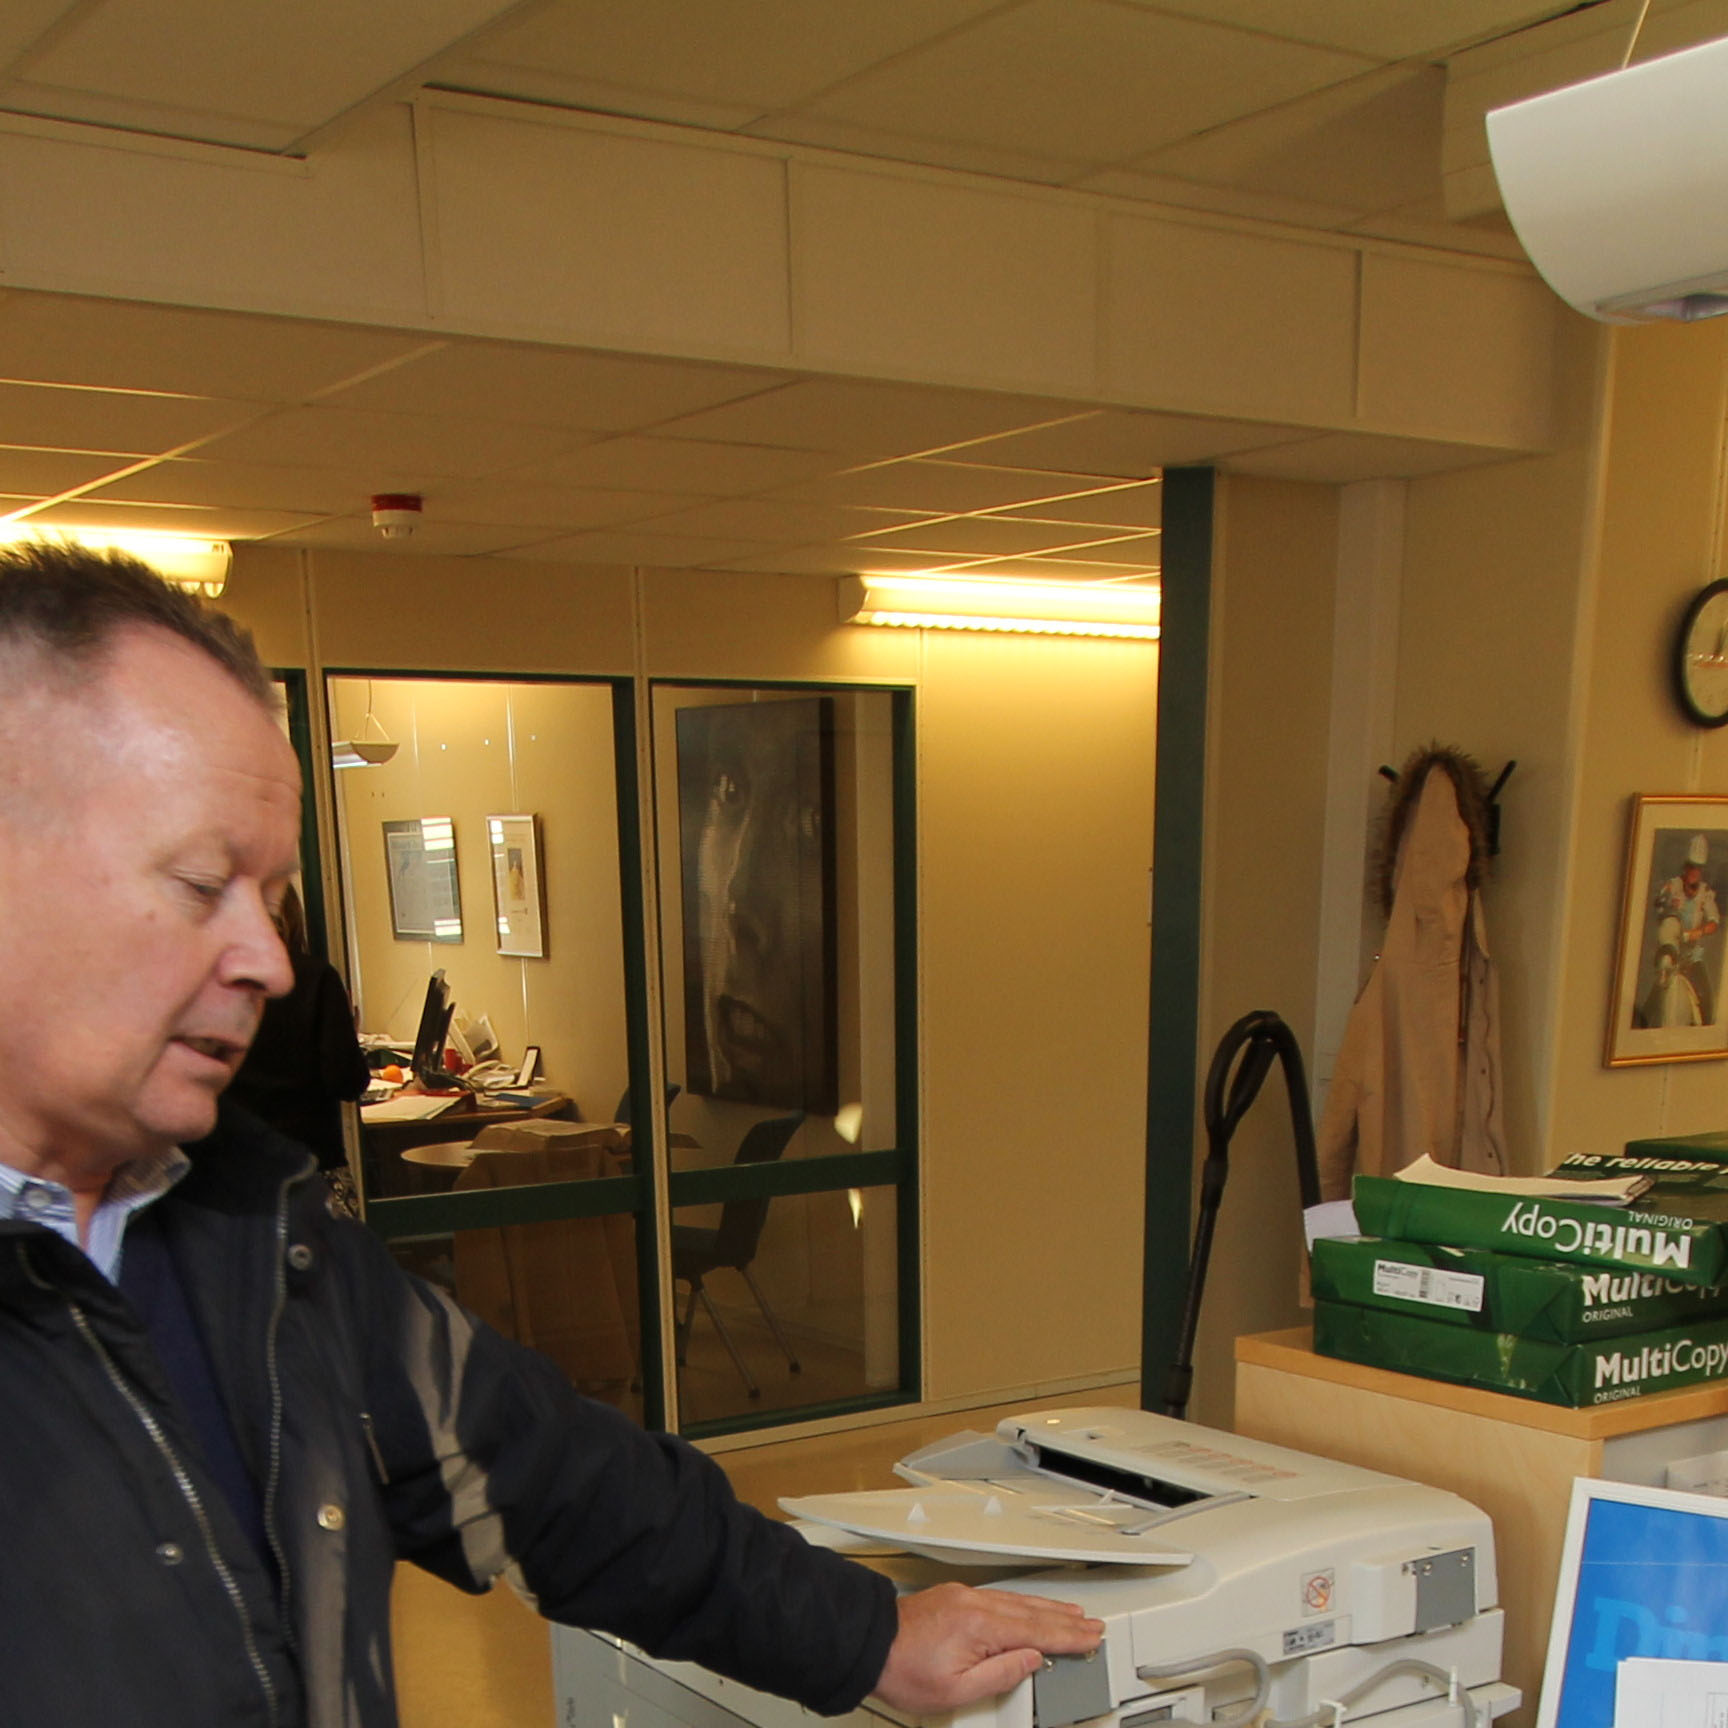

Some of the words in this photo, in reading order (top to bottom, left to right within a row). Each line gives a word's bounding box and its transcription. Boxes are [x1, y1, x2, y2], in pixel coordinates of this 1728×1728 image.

[1564, 1152, 1601, 1167] he
[1606, 1157, 1719, 1171] reliable
[1628, 1211, 1693, 1230] ORIGINAL
[1501, 1202, 1692, 1268] MultiCopy
[1582, 1306, 1633, 1323] ORIGINAL
[1594, 1385, 1641, 1404] ORIGINAL
